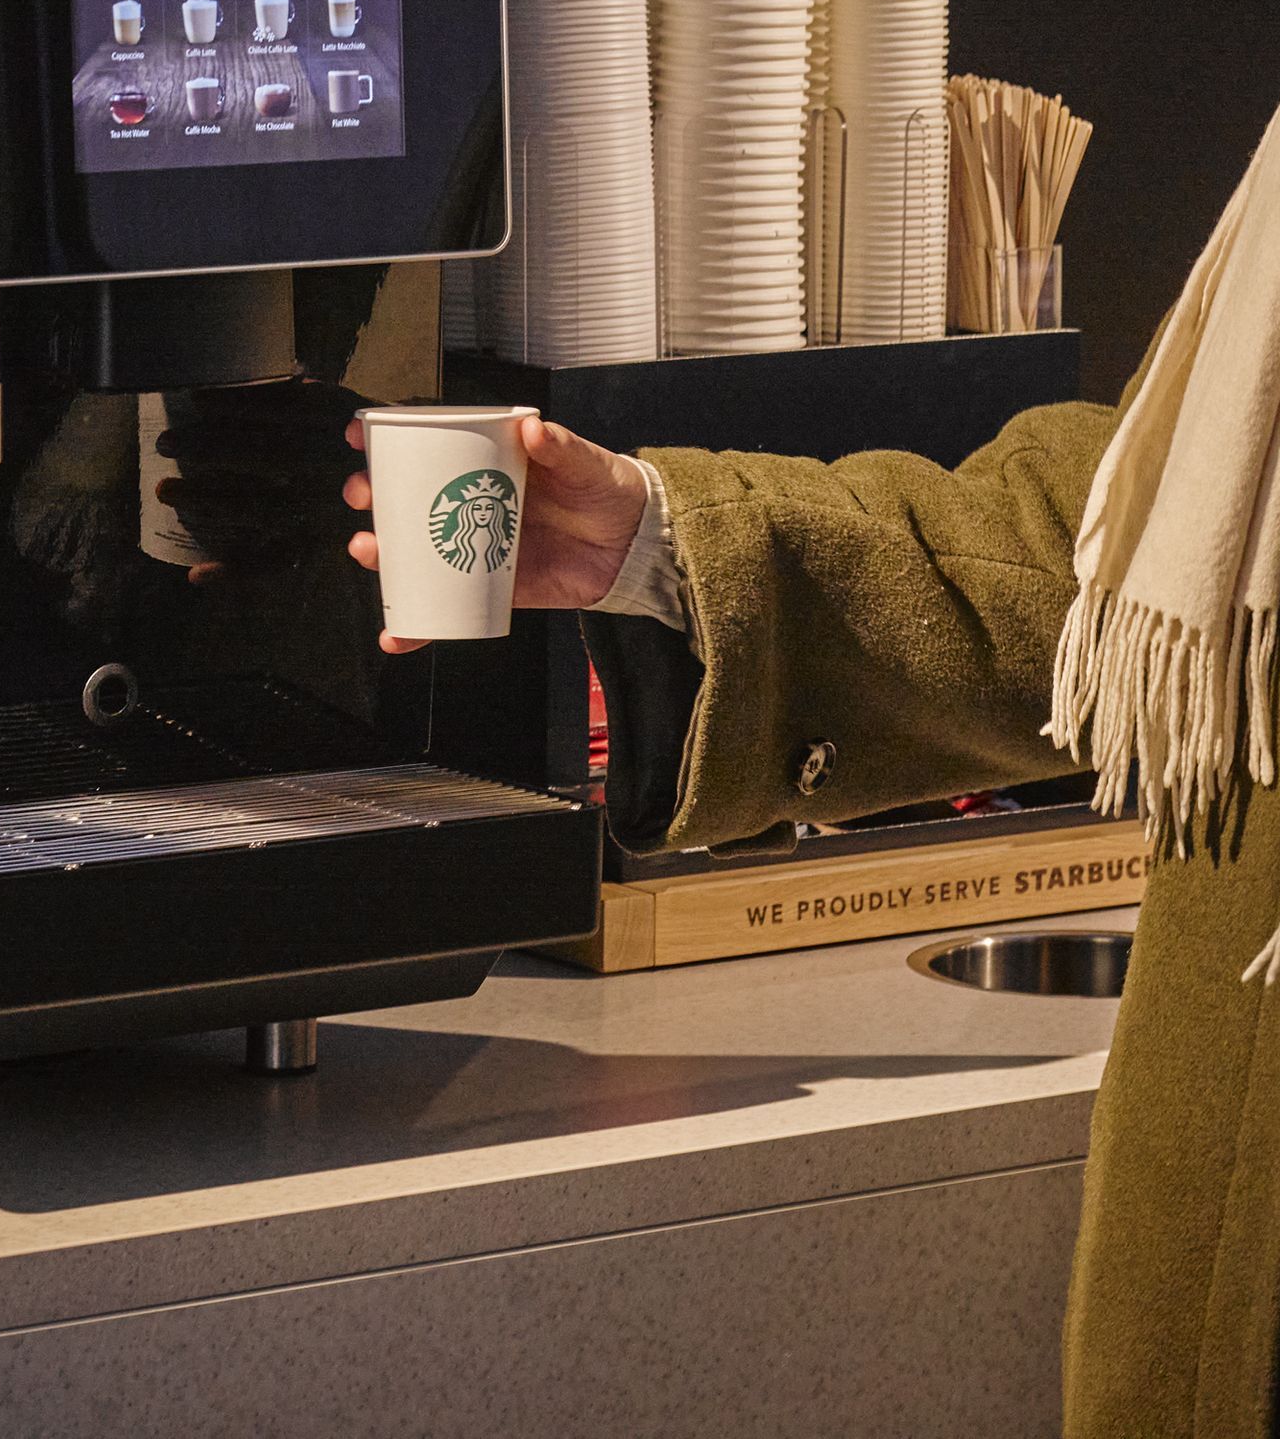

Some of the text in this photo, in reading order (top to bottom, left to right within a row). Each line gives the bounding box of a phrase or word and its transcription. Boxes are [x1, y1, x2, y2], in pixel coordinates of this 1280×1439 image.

[112, 51, 144, 60] Cappuccino
[746, 856, 1151, 927] WE PROUDLY SERVE STARBUC
